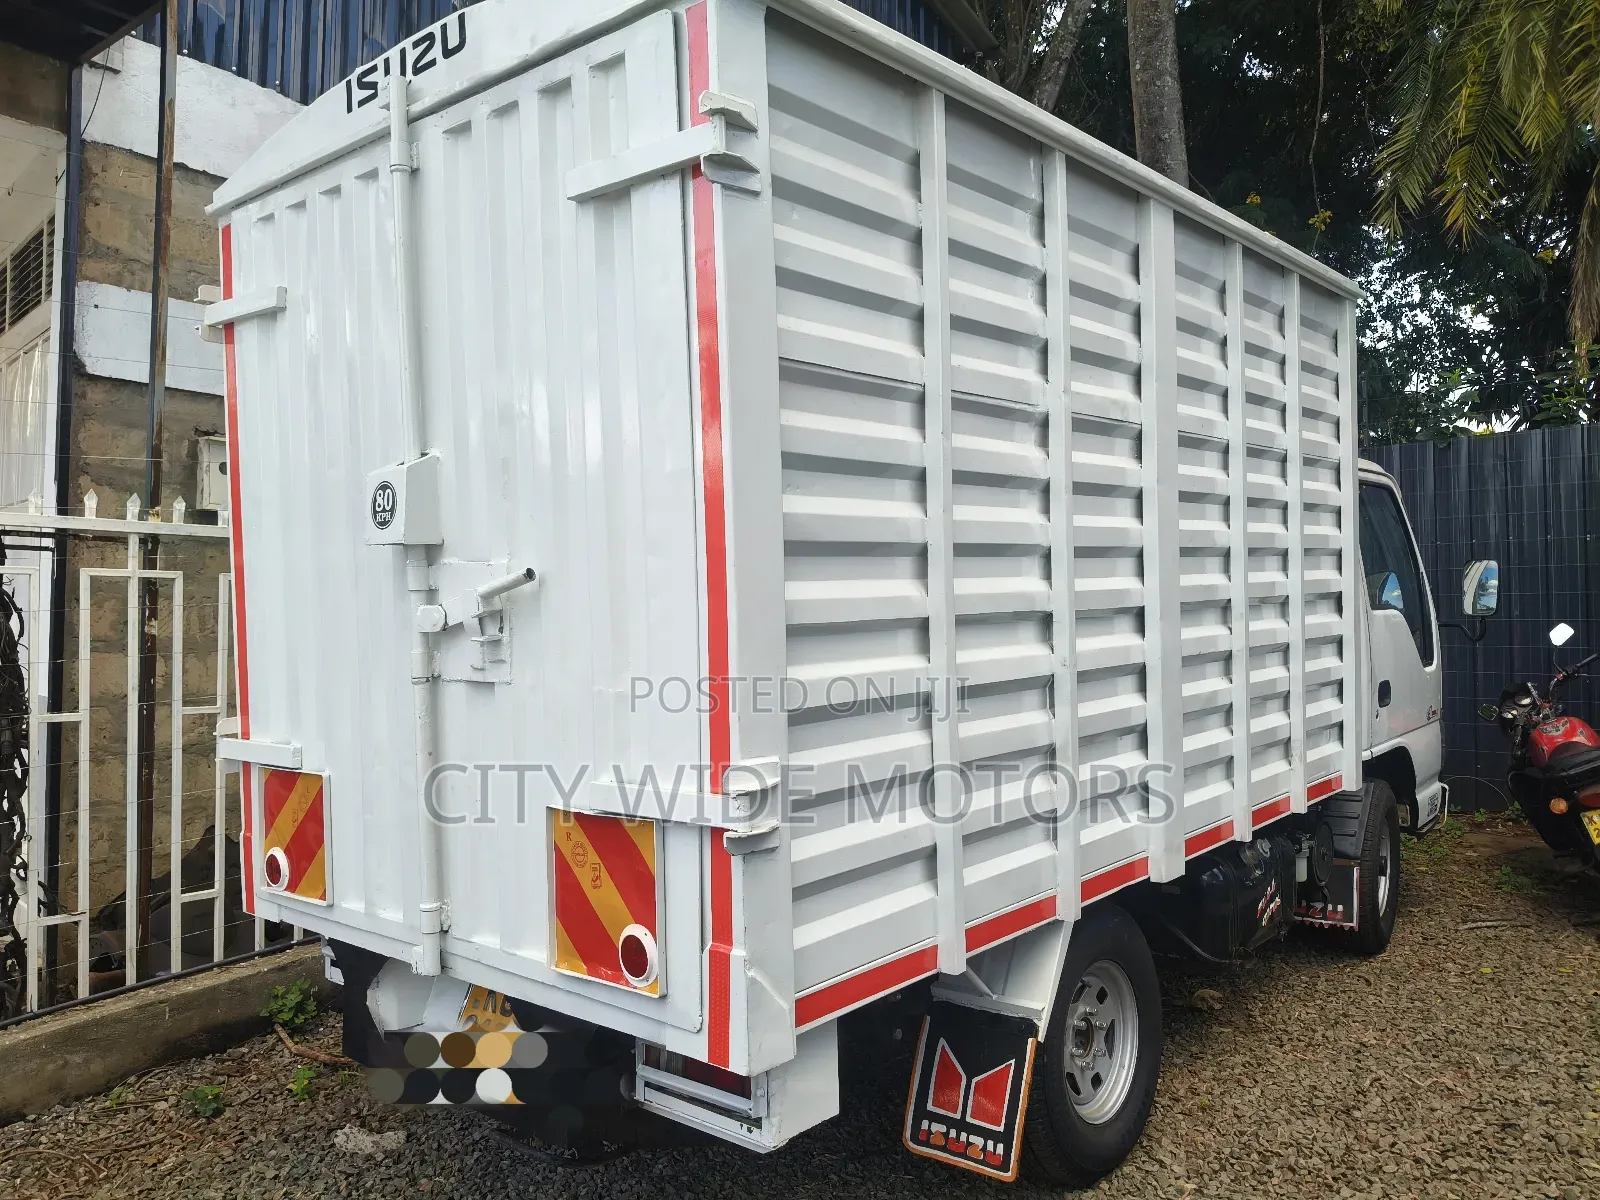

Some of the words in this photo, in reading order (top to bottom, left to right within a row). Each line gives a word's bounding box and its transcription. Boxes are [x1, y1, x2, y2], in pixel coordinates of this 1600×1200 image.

[345, 12, 467, 114] ISUZU
[375, 488, 393, 512] 80
[375, 511, 392, 522] KPH
[565, 831, 572, 841] R
[918, 1119, 1004, 1167] ISUZU
